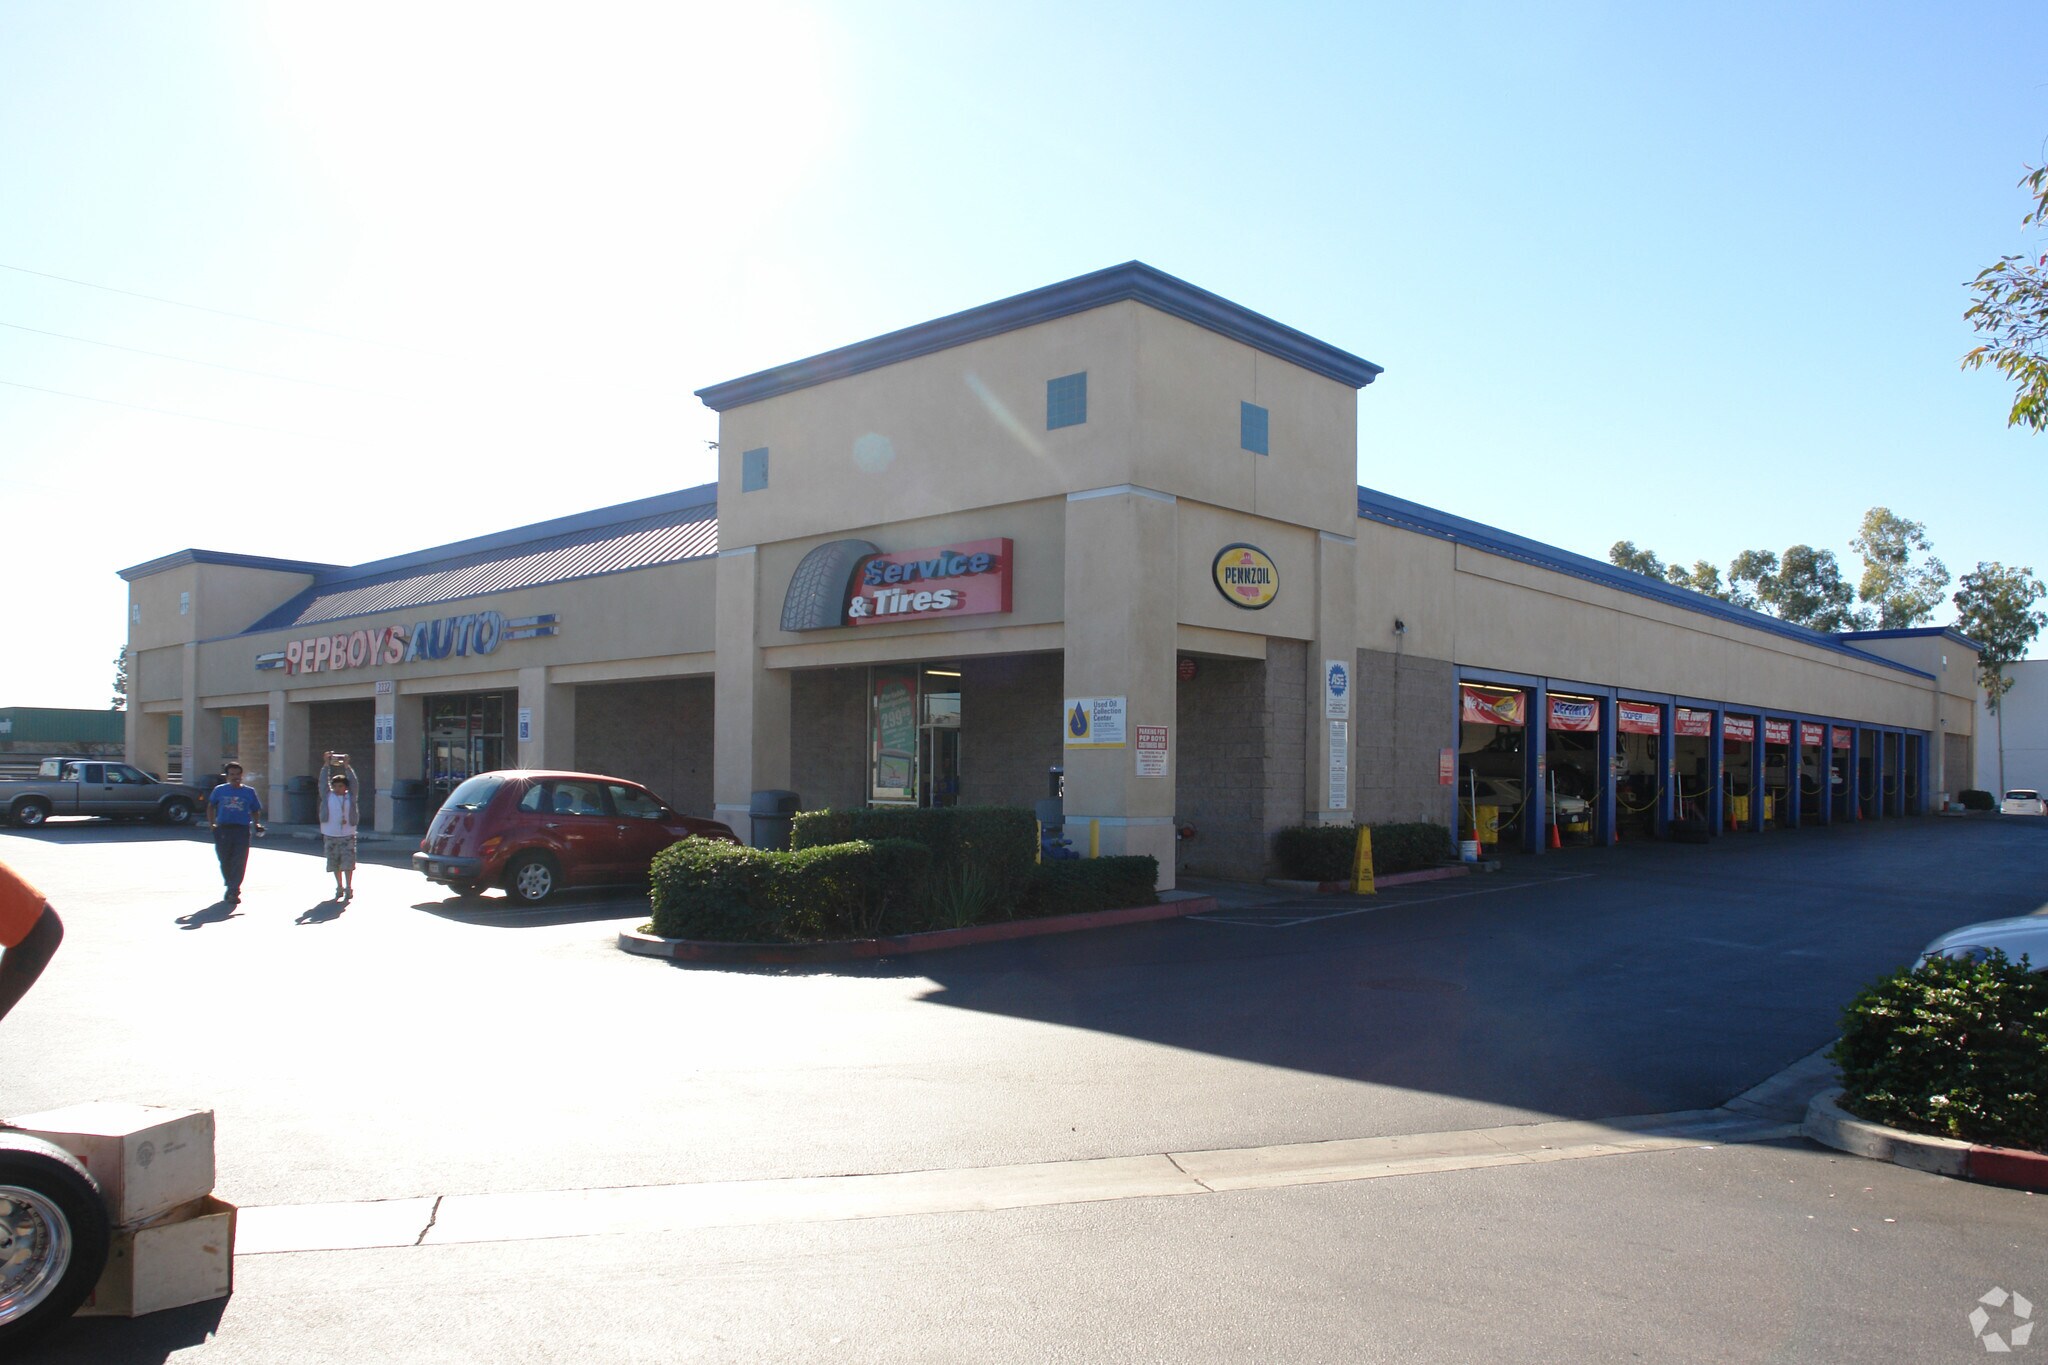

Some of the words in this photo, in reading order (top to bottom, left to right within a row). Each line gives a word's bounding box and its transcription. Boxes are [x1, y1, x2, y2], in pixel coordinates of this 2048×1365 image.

[864, 551, 992, 585] Service
[1225, 566, 1271, 585] PENNZOIL
[849, 596, 868, 618] &
[873, 588, 954, 615] Tires
[404, 610, 502, 664] AUTO
[1331, 673, 1345, 685] ASE
[1109, 700, 1117, 708] Oil
[1464, 696, 1477, 710] We
[1553, 702, 1593, 717] DEFINITY
